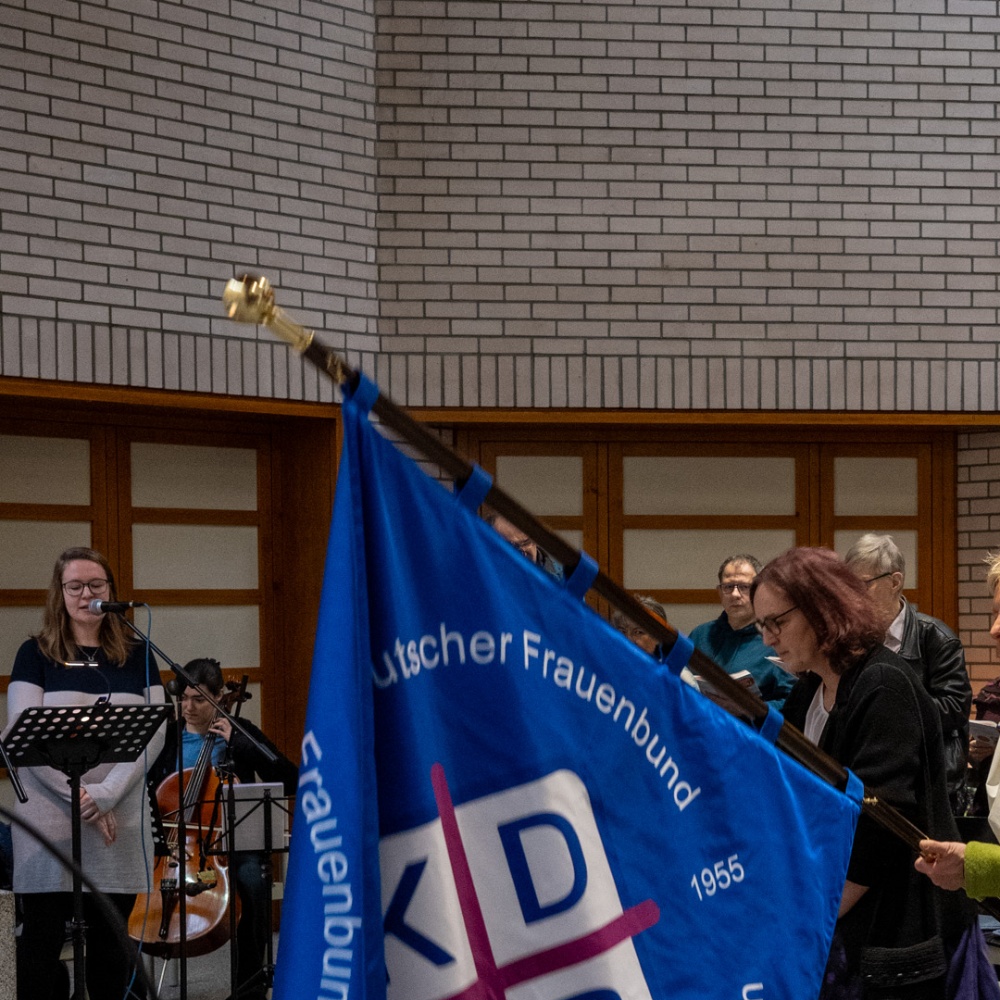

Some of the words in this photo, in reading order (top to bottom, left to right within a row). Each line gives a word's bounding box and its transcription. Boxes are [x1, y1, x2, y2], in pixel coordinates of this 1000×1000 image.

[522, 629, 702, 813] Frauenbund
[497, 811, 589, 927] D
[690, 854, 746, 901] 1955
